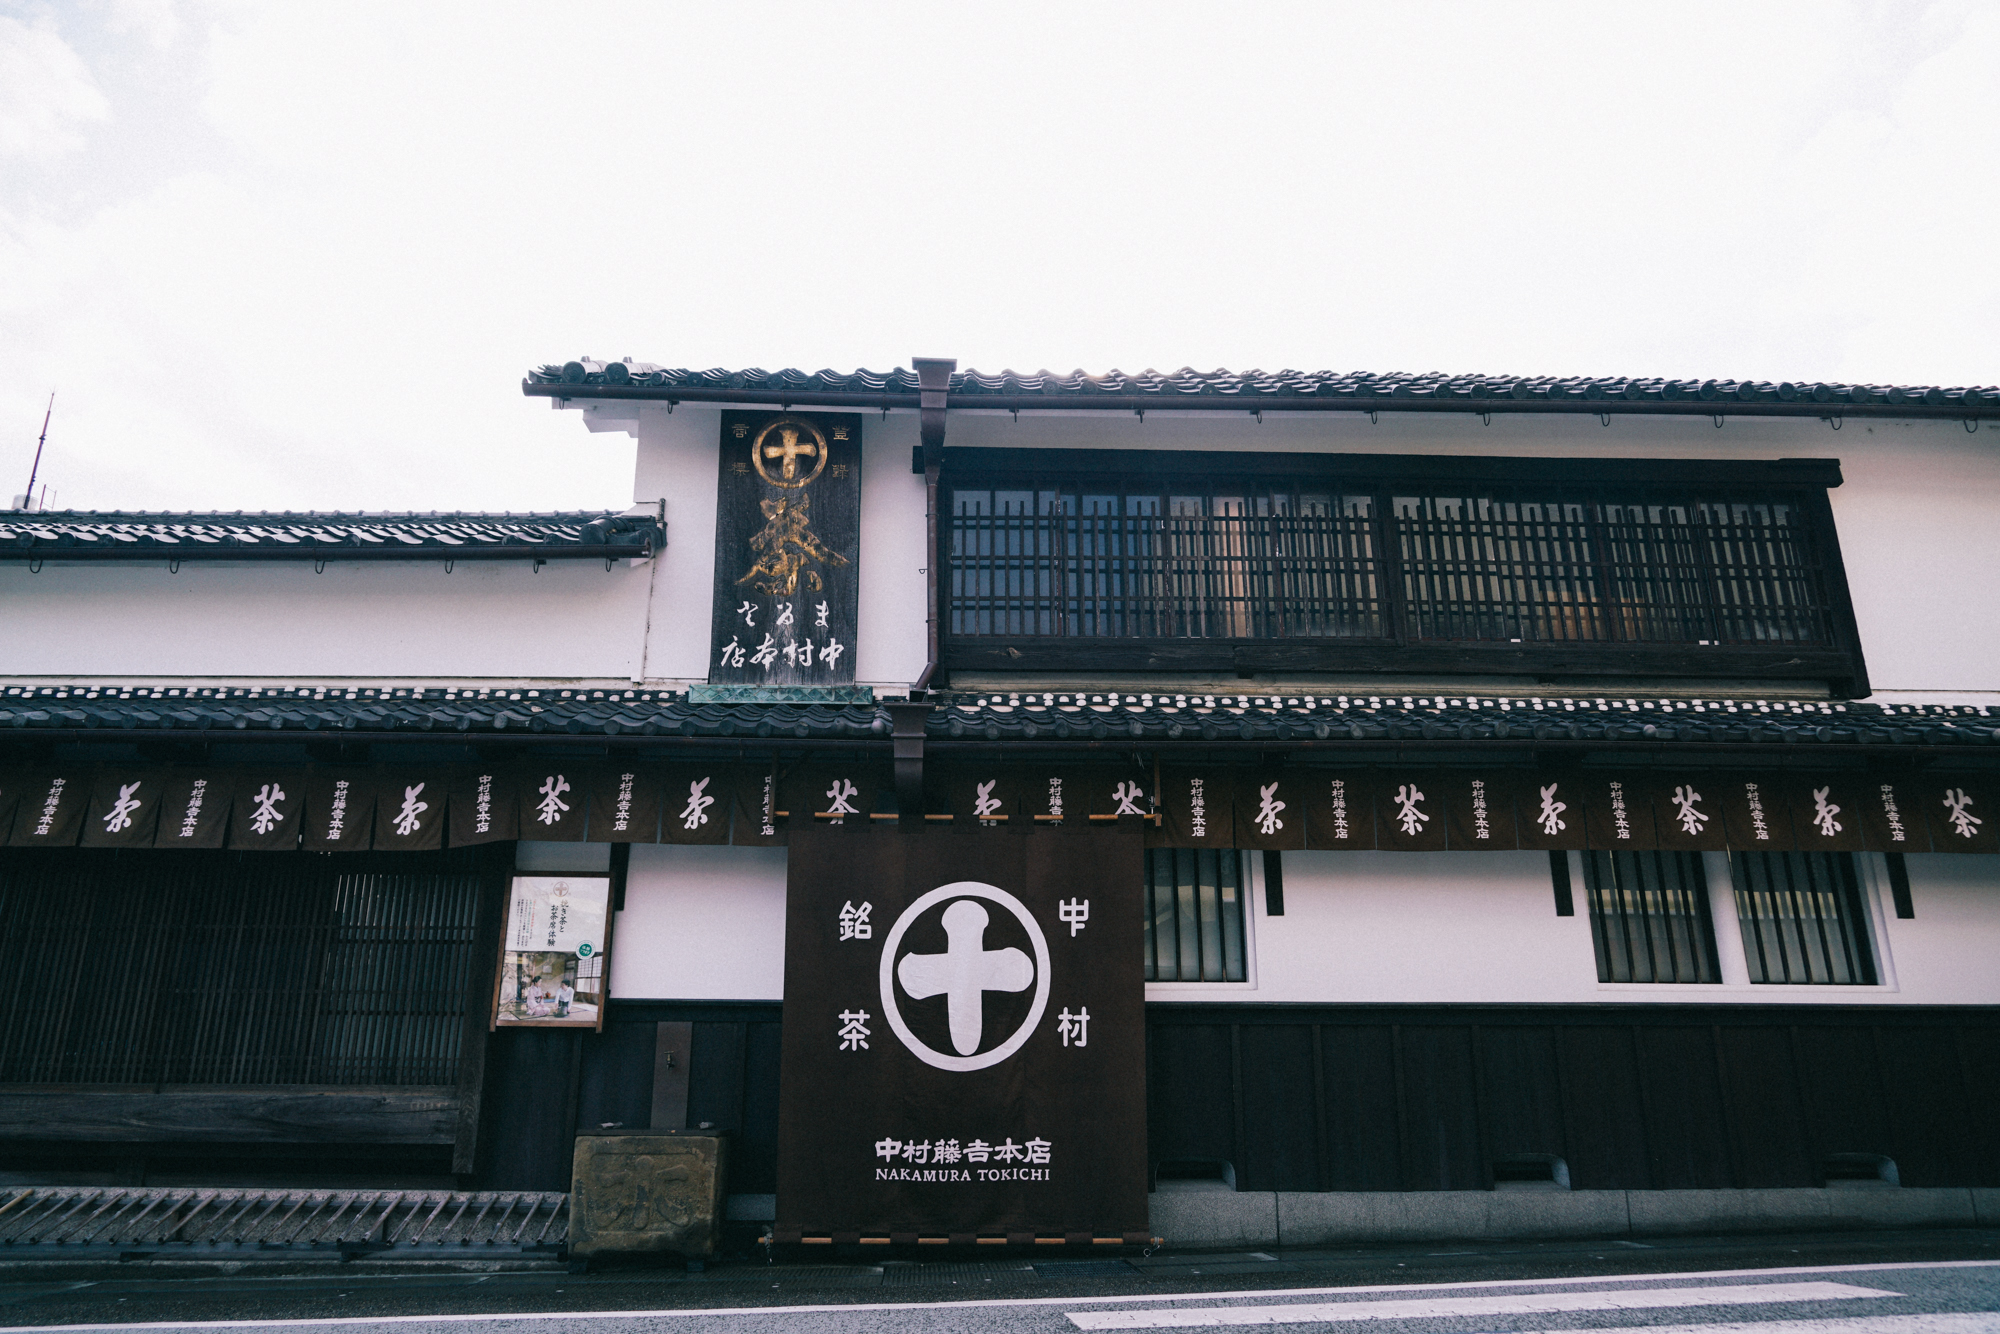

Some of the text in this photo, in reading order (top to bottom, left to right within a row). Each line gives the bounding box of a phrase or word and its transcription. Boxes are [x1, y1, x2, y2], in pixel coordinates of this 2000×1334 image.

[874, 1136, 1052, 1164] 中村藤吉本店
[875, 1168, 1050, 1182] NAKAMURA TOKICHI
